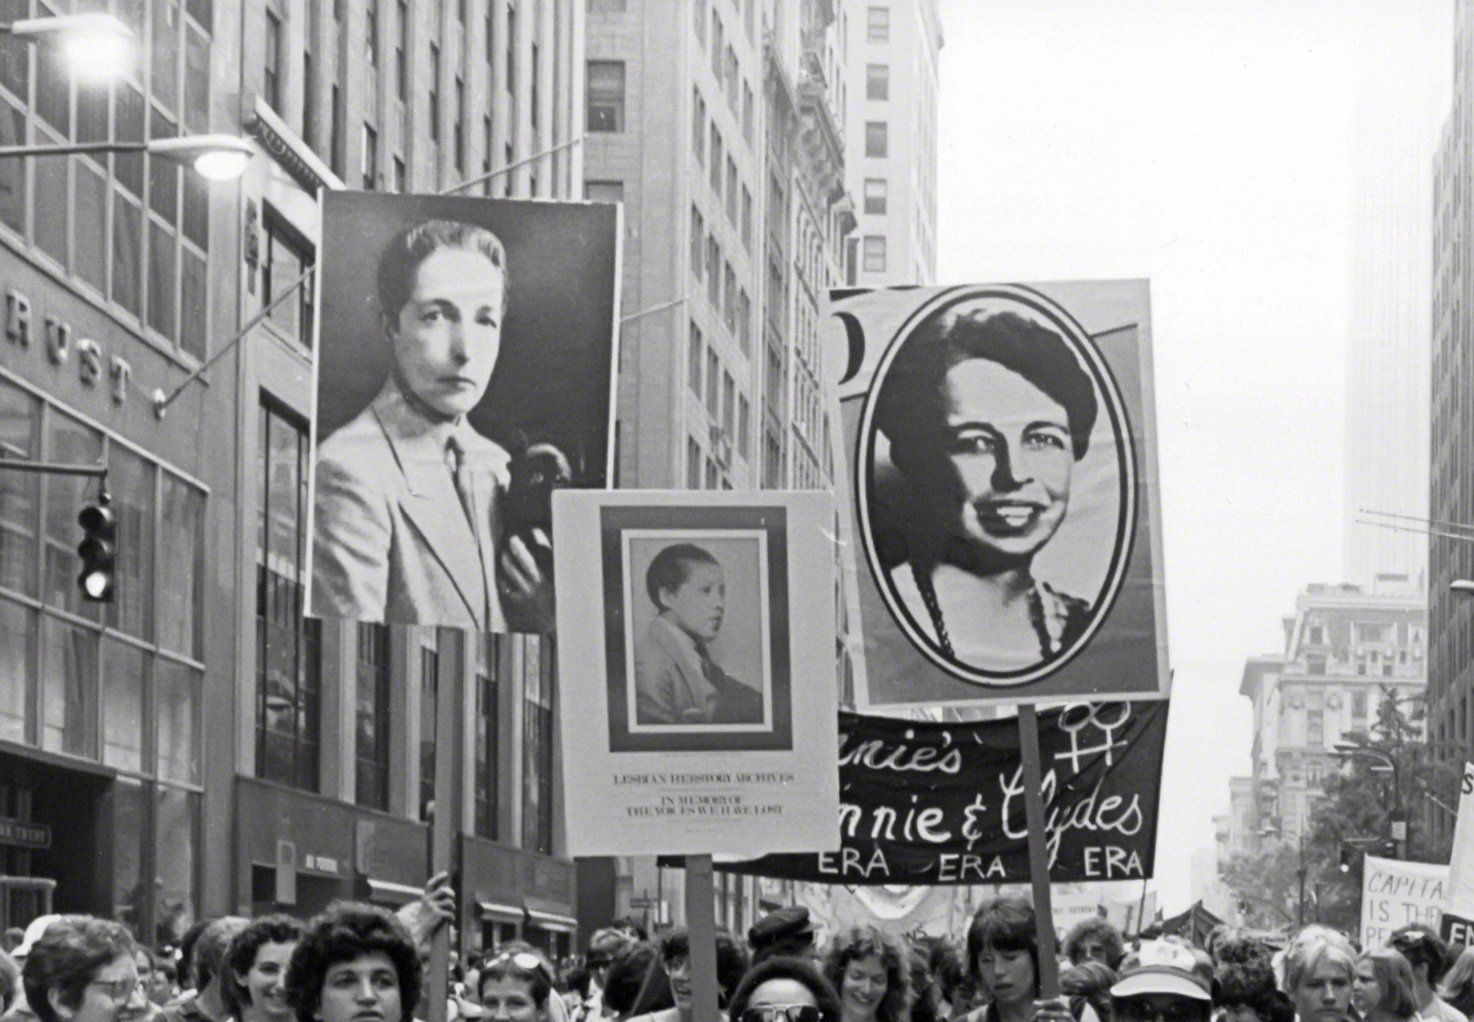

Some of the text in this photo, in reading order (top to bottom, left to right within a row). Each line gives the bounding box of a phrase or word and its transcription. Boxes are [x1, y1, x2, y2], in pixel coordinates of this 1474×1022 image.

[4, 290, 131, 406] RUST
[612, 772, 795, 785] LESBIAN HERSTORY ARCHIVES
[660, 796, 675, 806] IN
[677, 795, 727, 805] MEMORY
[626, 806, 651, 817] THE
[754, 804, 784, 815] LOST
[819, 847, 1144, 882] ERA ERA ERA
[1370, 899, 1390, 922] IS
